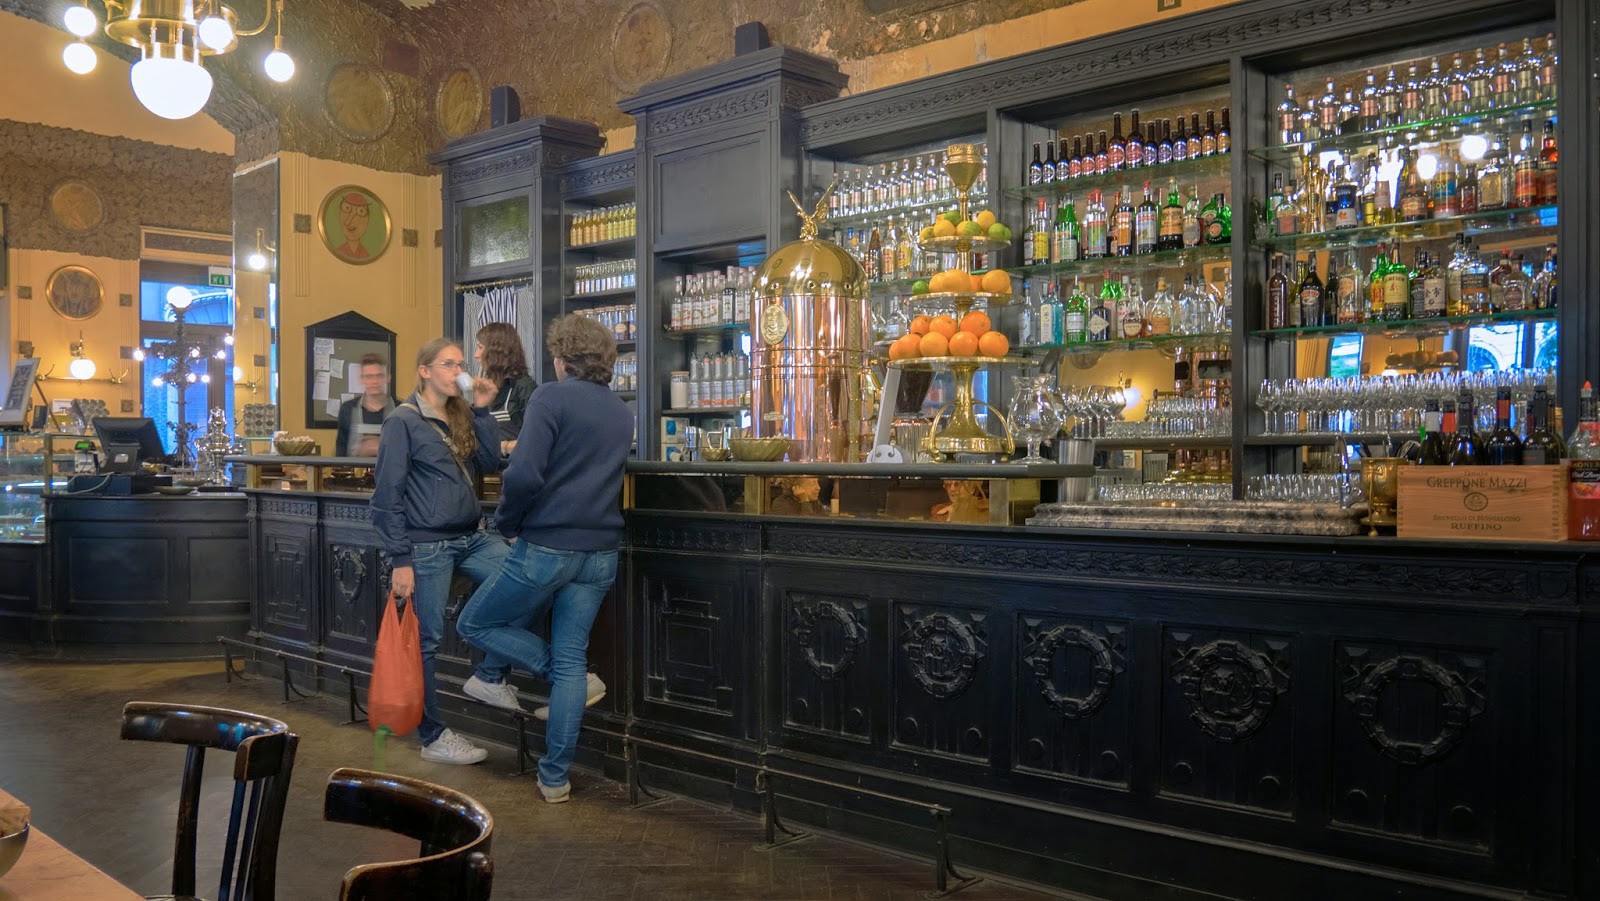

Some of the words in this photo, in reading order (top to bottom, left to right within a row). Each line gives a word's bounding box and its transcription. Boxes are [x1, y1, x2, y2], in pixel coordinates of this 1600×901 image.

[1426, 476, 1486, 489] GREPPONE
[1488, 476, 1527, 488] MAZZI
[1450, 522, 1502, 531] RUFFINO
